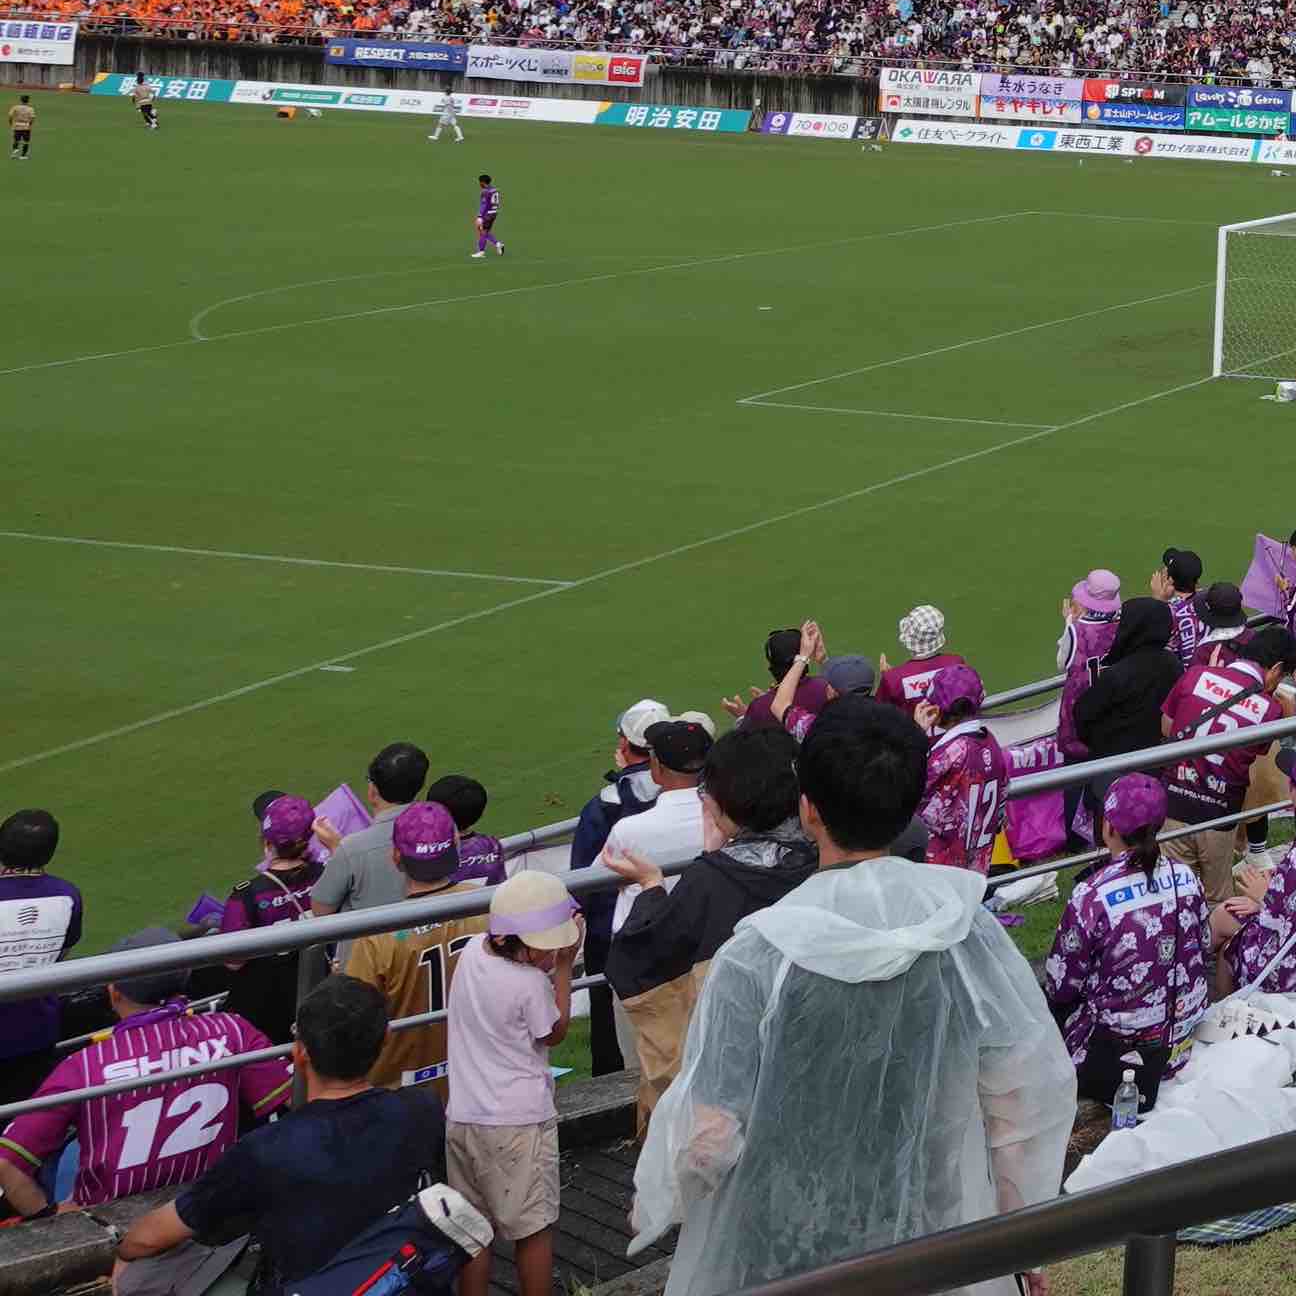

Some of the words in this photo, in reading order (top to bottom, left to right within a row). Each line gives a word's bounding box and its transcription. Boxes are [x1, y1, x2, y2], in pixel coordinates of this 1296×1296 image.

[469, 53, 538, 72] スポーツくじ
[888, 70, 973, 86] OKAWARA
[624, 105, 721, 131] 明治安田
[1189, 111, 1288, 131] アムールなかだ
[1060, 133, 1124, 151] 東西工業
[964, 780, 999, 851] 12
[104, 1035, 230, 1081] SHINX
[116, 1082, 229, 1170] 12
